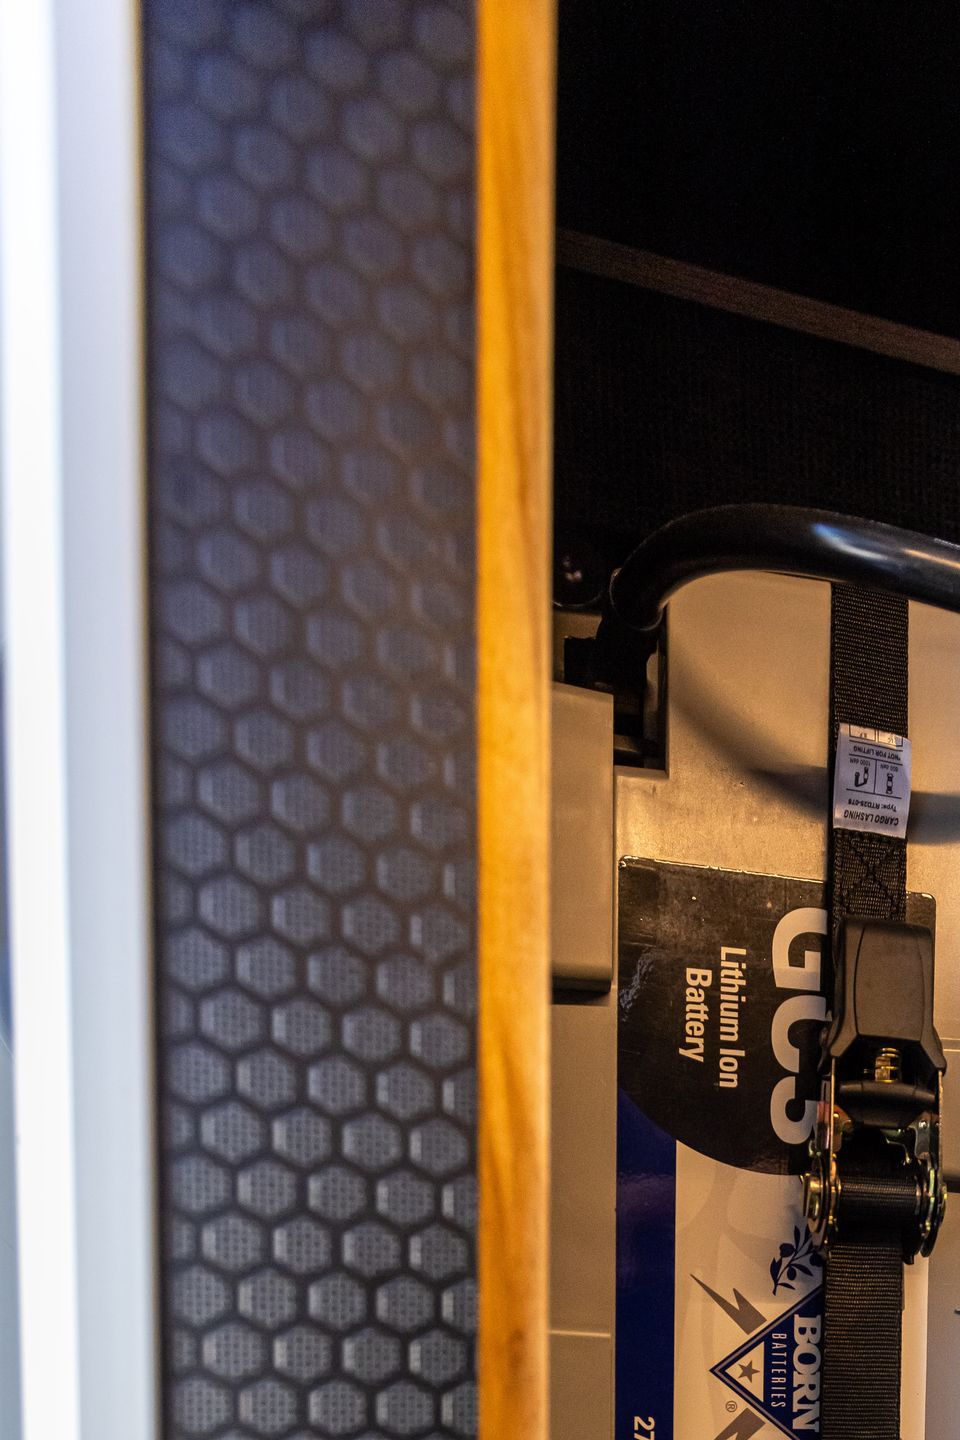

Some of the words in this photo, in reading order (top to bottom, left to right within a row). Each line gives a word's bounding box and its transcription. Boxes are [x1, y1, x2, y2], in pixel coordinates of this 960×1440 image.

[853, 745, 875, 755] LIFTING
[844, 810, 874, 822] LASHING
[875, 814, 899, 826] CARGO
[881, 803, 897, 812] Type:
[719, 946, 747, 1042] Lithium
[678, 967, 713, 1062] Battery
[719, 1048, 746, 1088] Ion
[770, 1333, 787, 1408] BATTERIES
[792, 1313, 821, 1433] BORN
